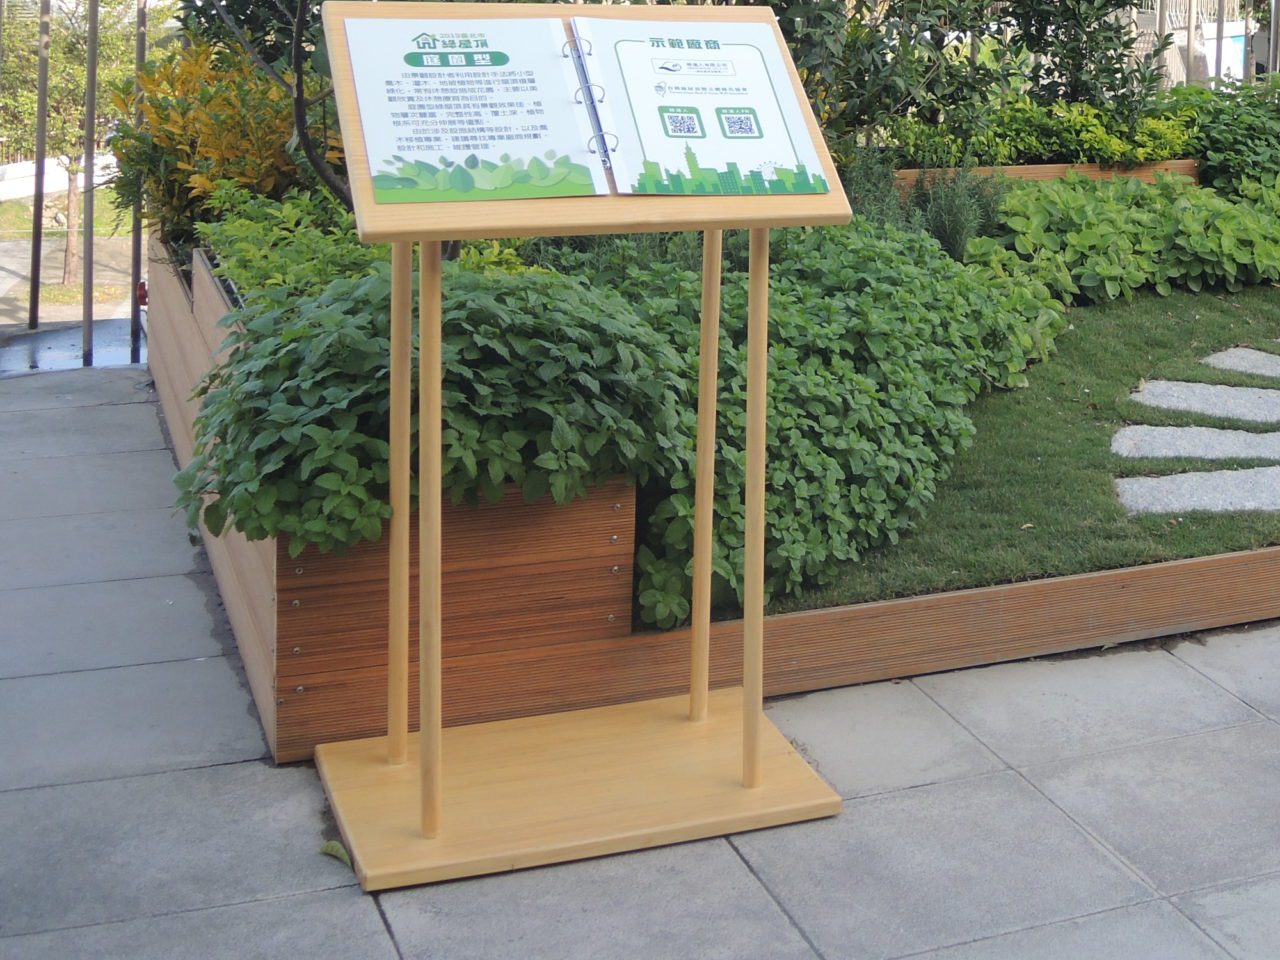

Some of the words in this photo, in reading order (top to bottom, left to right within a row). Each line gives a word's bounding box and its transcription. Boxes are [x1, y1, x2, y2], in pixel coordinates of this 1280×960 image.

[441, 38, 489, 49] 綠屋頂
[649, 37, 721, 50] 示範廠商
[423, 54, 492, 65] 庭園型
